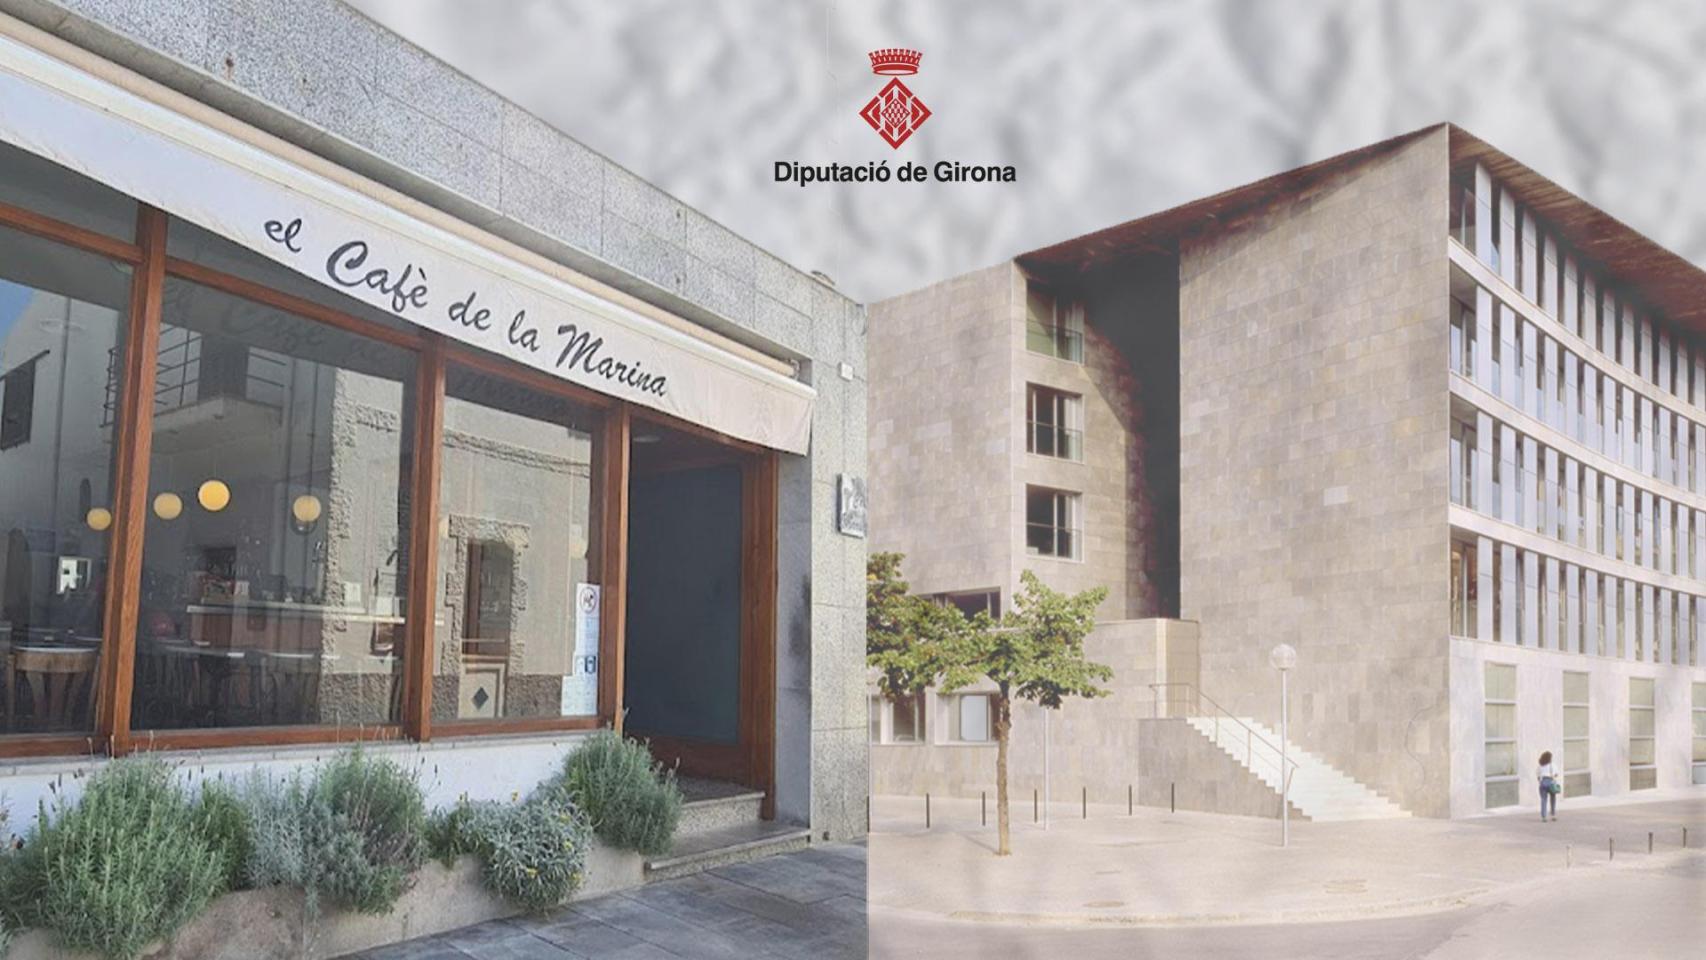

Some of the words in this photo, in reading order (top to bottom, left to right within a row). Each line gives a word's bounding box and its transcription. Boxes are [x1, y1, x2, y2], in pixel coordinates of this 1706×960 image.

[264, 218, 302, 253] el
[326, 240, 428, 313] Cafè
[448, 292, 492, 331] de
[508, 310, 540, 352] la
[557, 324, 669, 397] Marina
